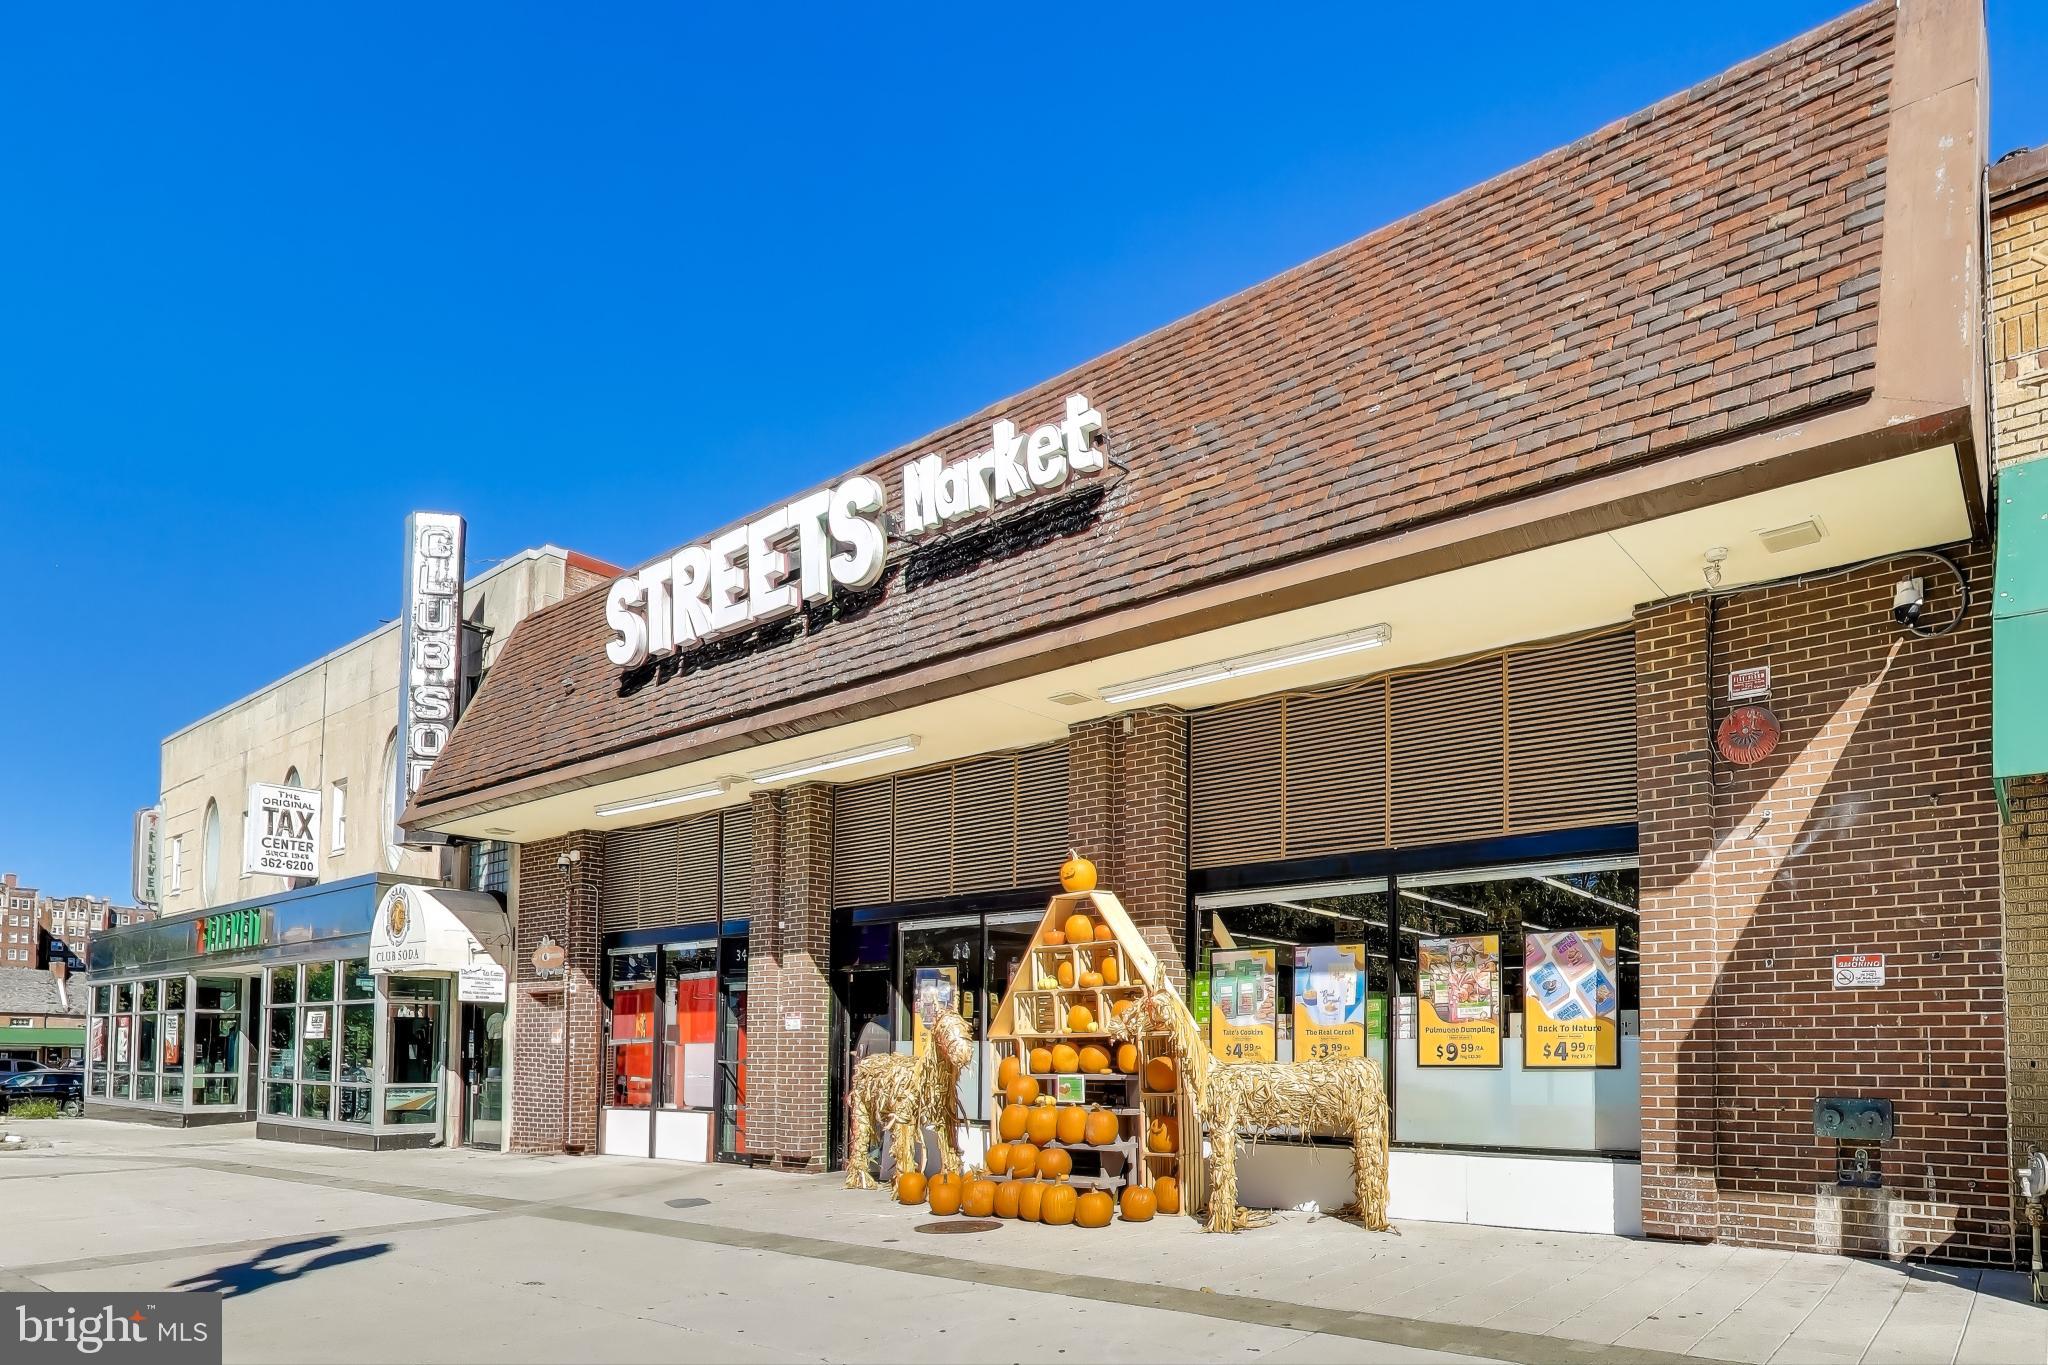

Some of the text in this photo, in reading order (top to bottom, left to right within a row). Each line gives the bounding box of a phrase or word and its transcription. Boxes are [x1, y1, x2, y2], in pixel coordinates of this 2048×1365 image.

[605, 393, 1107, 669] STREETS Market
[416, 525, 454, 670] CLUB
[278, 790, 301, 801] THE
[262, 797, 315, 811] ORIGINAL
[261, 806, 315, 841] TAX
[261, 837, 314, 853] CENTER
[376, 949, 419, 963] CLUB SODA
[1460, 1026, 1496, 1034] Dumpling
[1537, 1024, 1602, 1032] Back To Nature
